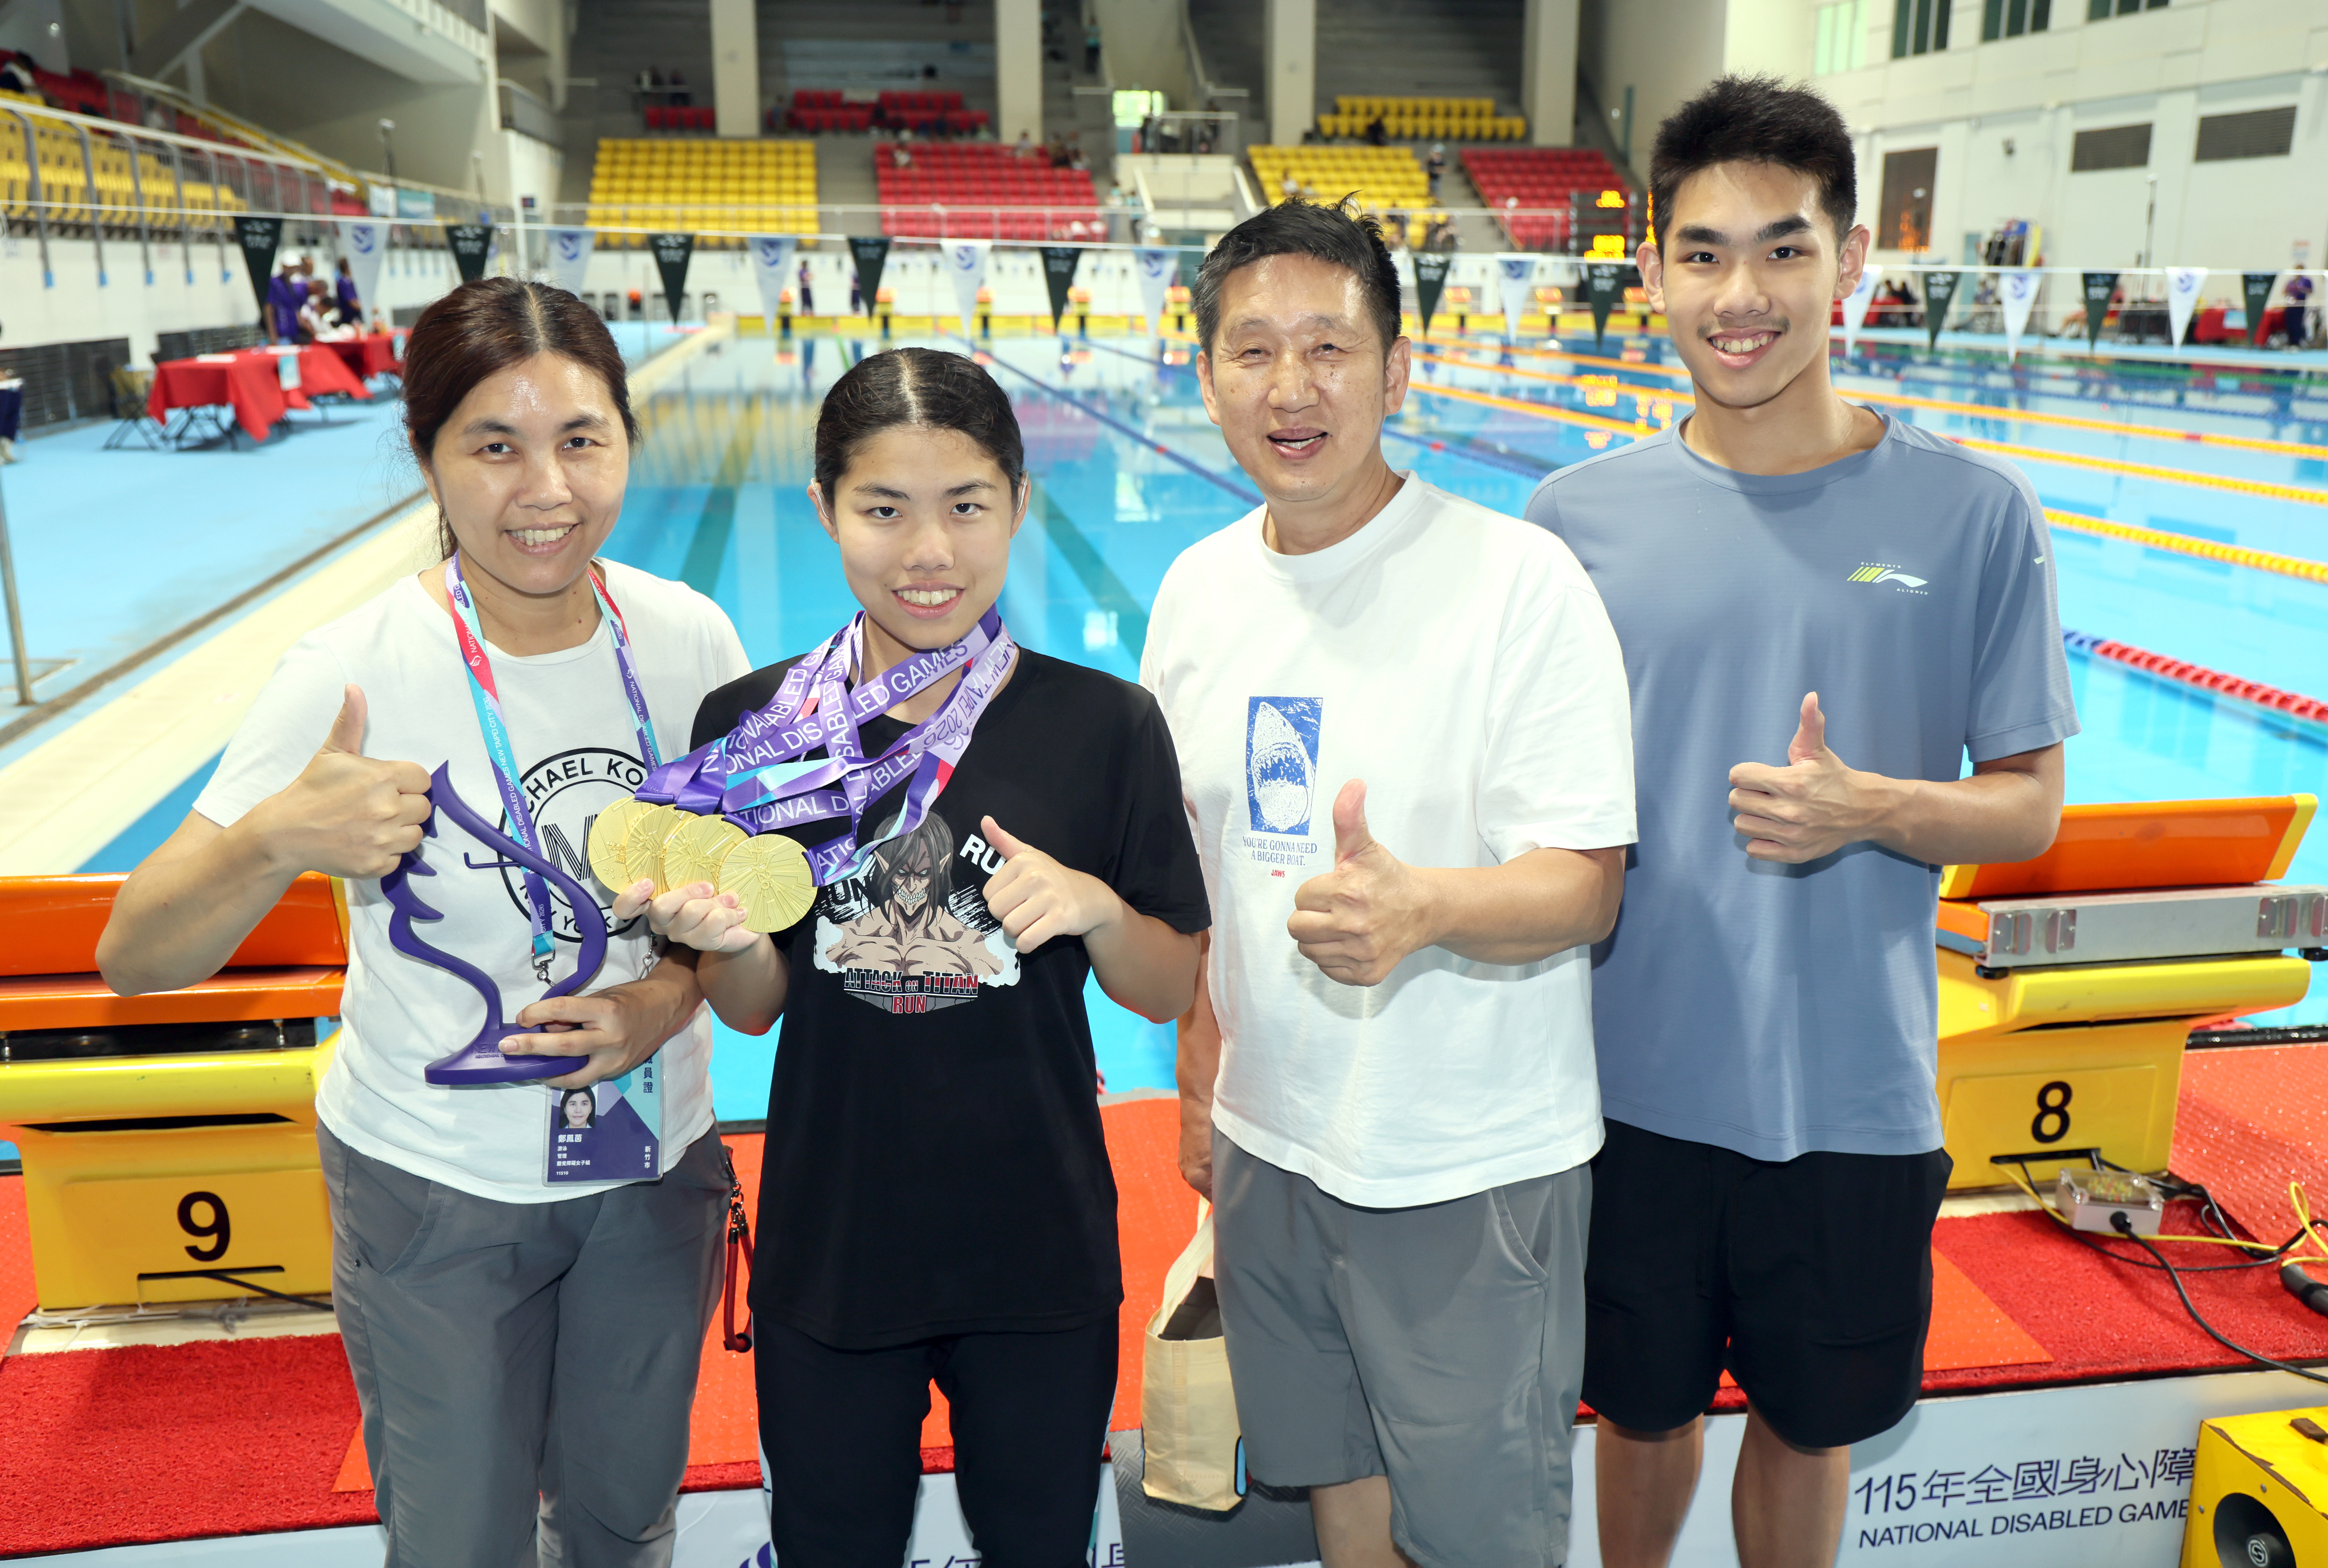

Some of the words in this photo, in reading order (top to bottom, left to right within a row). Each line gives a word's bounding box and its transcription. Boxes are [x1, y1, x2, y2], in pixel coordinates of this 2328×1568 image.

[594, 579, 603, 594] NEW
[456, 590, 470, 620] DISABLED
[465, 620, 477, 653] NATIONAL
[891, 638, 968, 693] GAMES
[493, 728, 502, 751] TAIPEI
[630, 681, 641, 714] NATIONAL
[639, 715, 651, 746] DISABLED
[647, 747, 657, 771] GAMES
[924, 708, 962, 749] 2026
[499, 751, 507, 765] NEW
[503, 767, 514, 792] GAMES
[511, 792, 524, 825] DISABLED
[1242, 836, 1267, 849] YOU'RE
[1270, 840, 1295, 852] GONNA
[1296, 842, 1317, 853] NEED
[1251, 850, 1256, 860] A
[1257, 851, 1285, 864] BIGGER
[1287, 854, 1305, 865] BOAT.
[1271, 869, 1285, 878] JAWS
[844, 967, 903, 992] ATTACK
[905, 980, 918, 992] ON
[922, 970, 979, 995] TITAN
[892, 995, 926, 1014] RUN
[2031, 1080, 2073, 1144] 8
[176, 1191, 231, 1262] 9
[1859, 1519, 1984, 1549] NATIONAL
[1991, 1505, 2112, 1535] DISABLED
